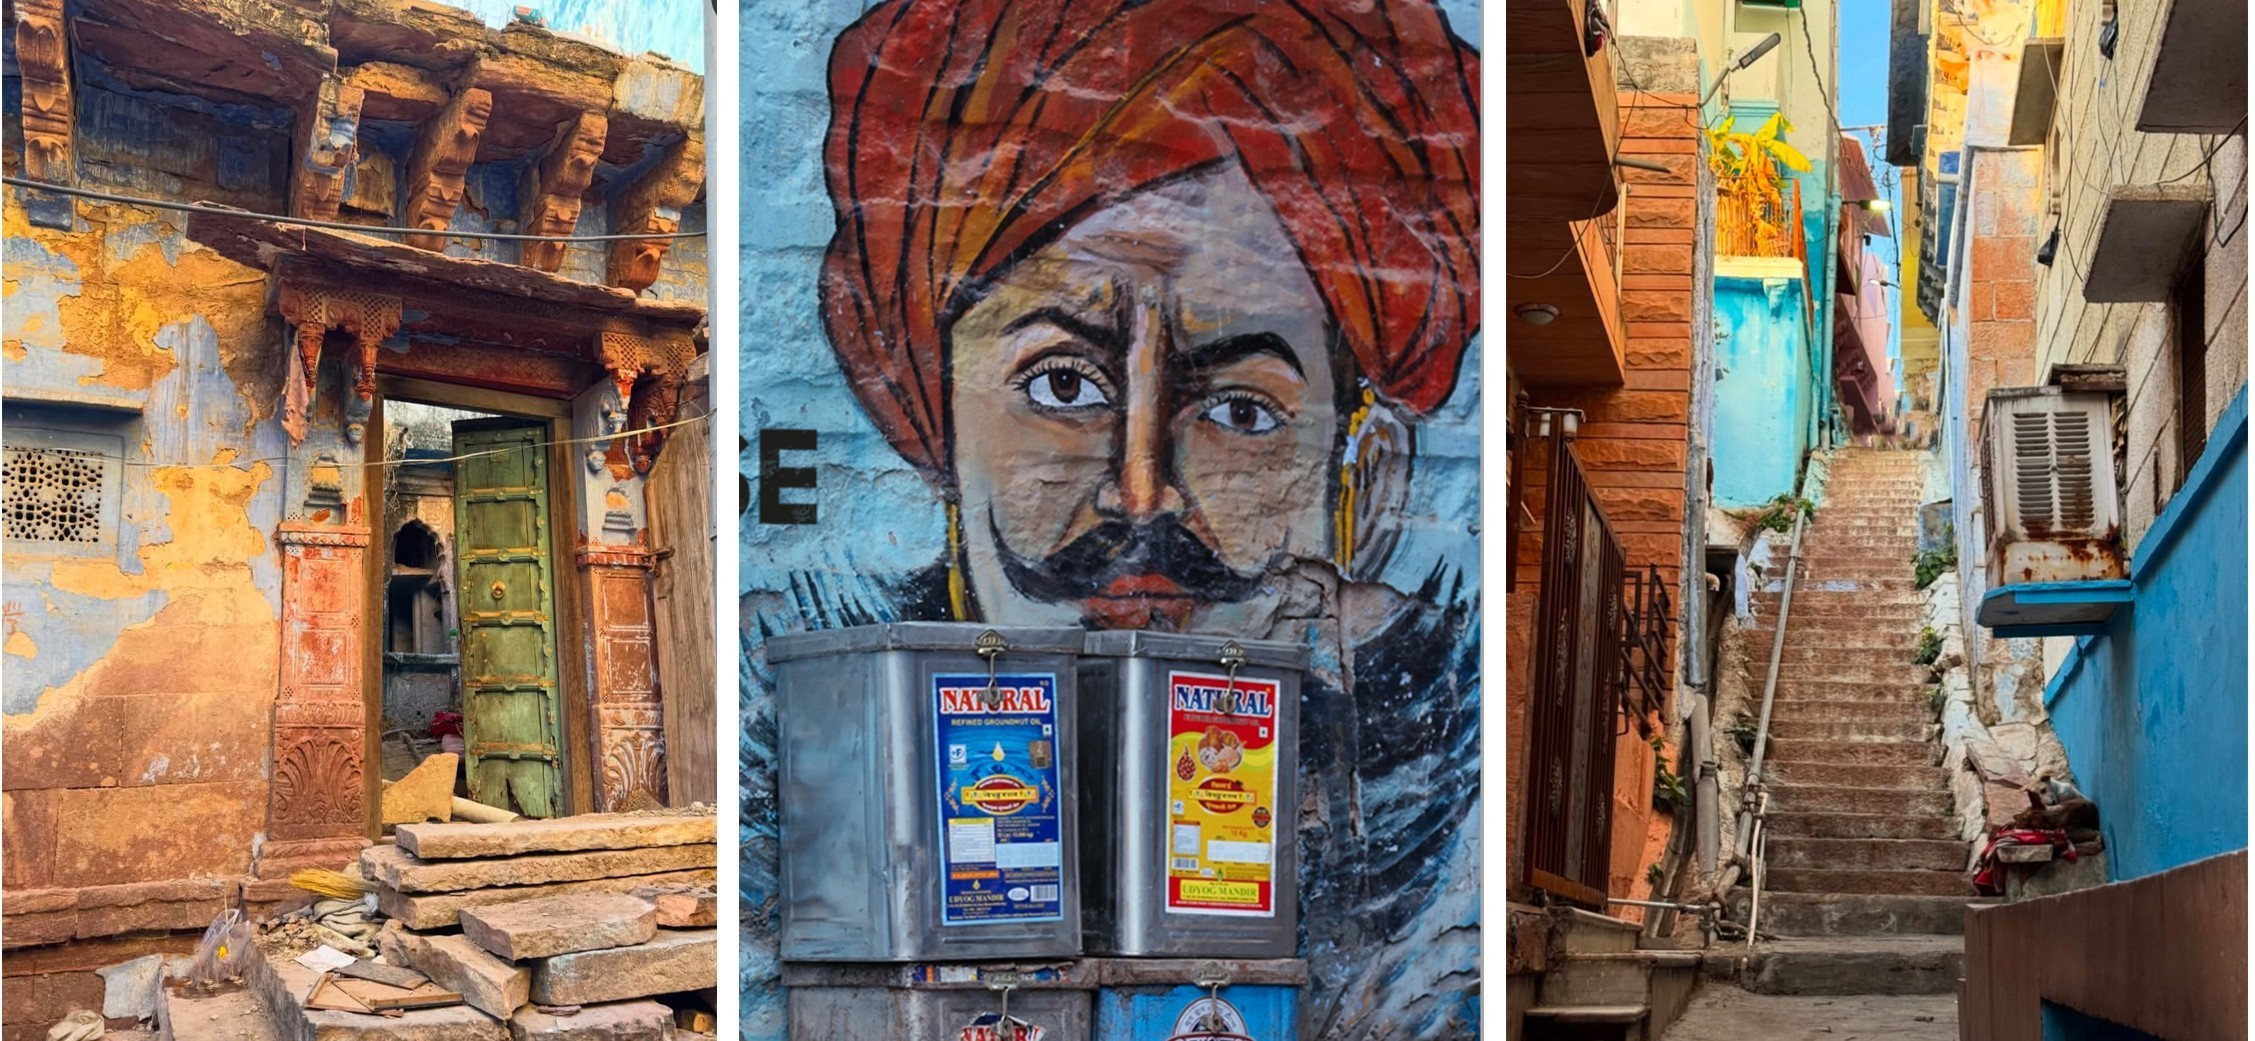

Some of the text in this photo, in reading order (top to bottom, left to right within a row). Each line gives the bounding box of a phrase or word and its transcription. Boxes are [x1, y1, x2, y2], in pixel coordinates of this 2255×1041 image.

[739, 429, 817, 524] E
[1182, 885, 1257, 897] UDYOG MANDIR
